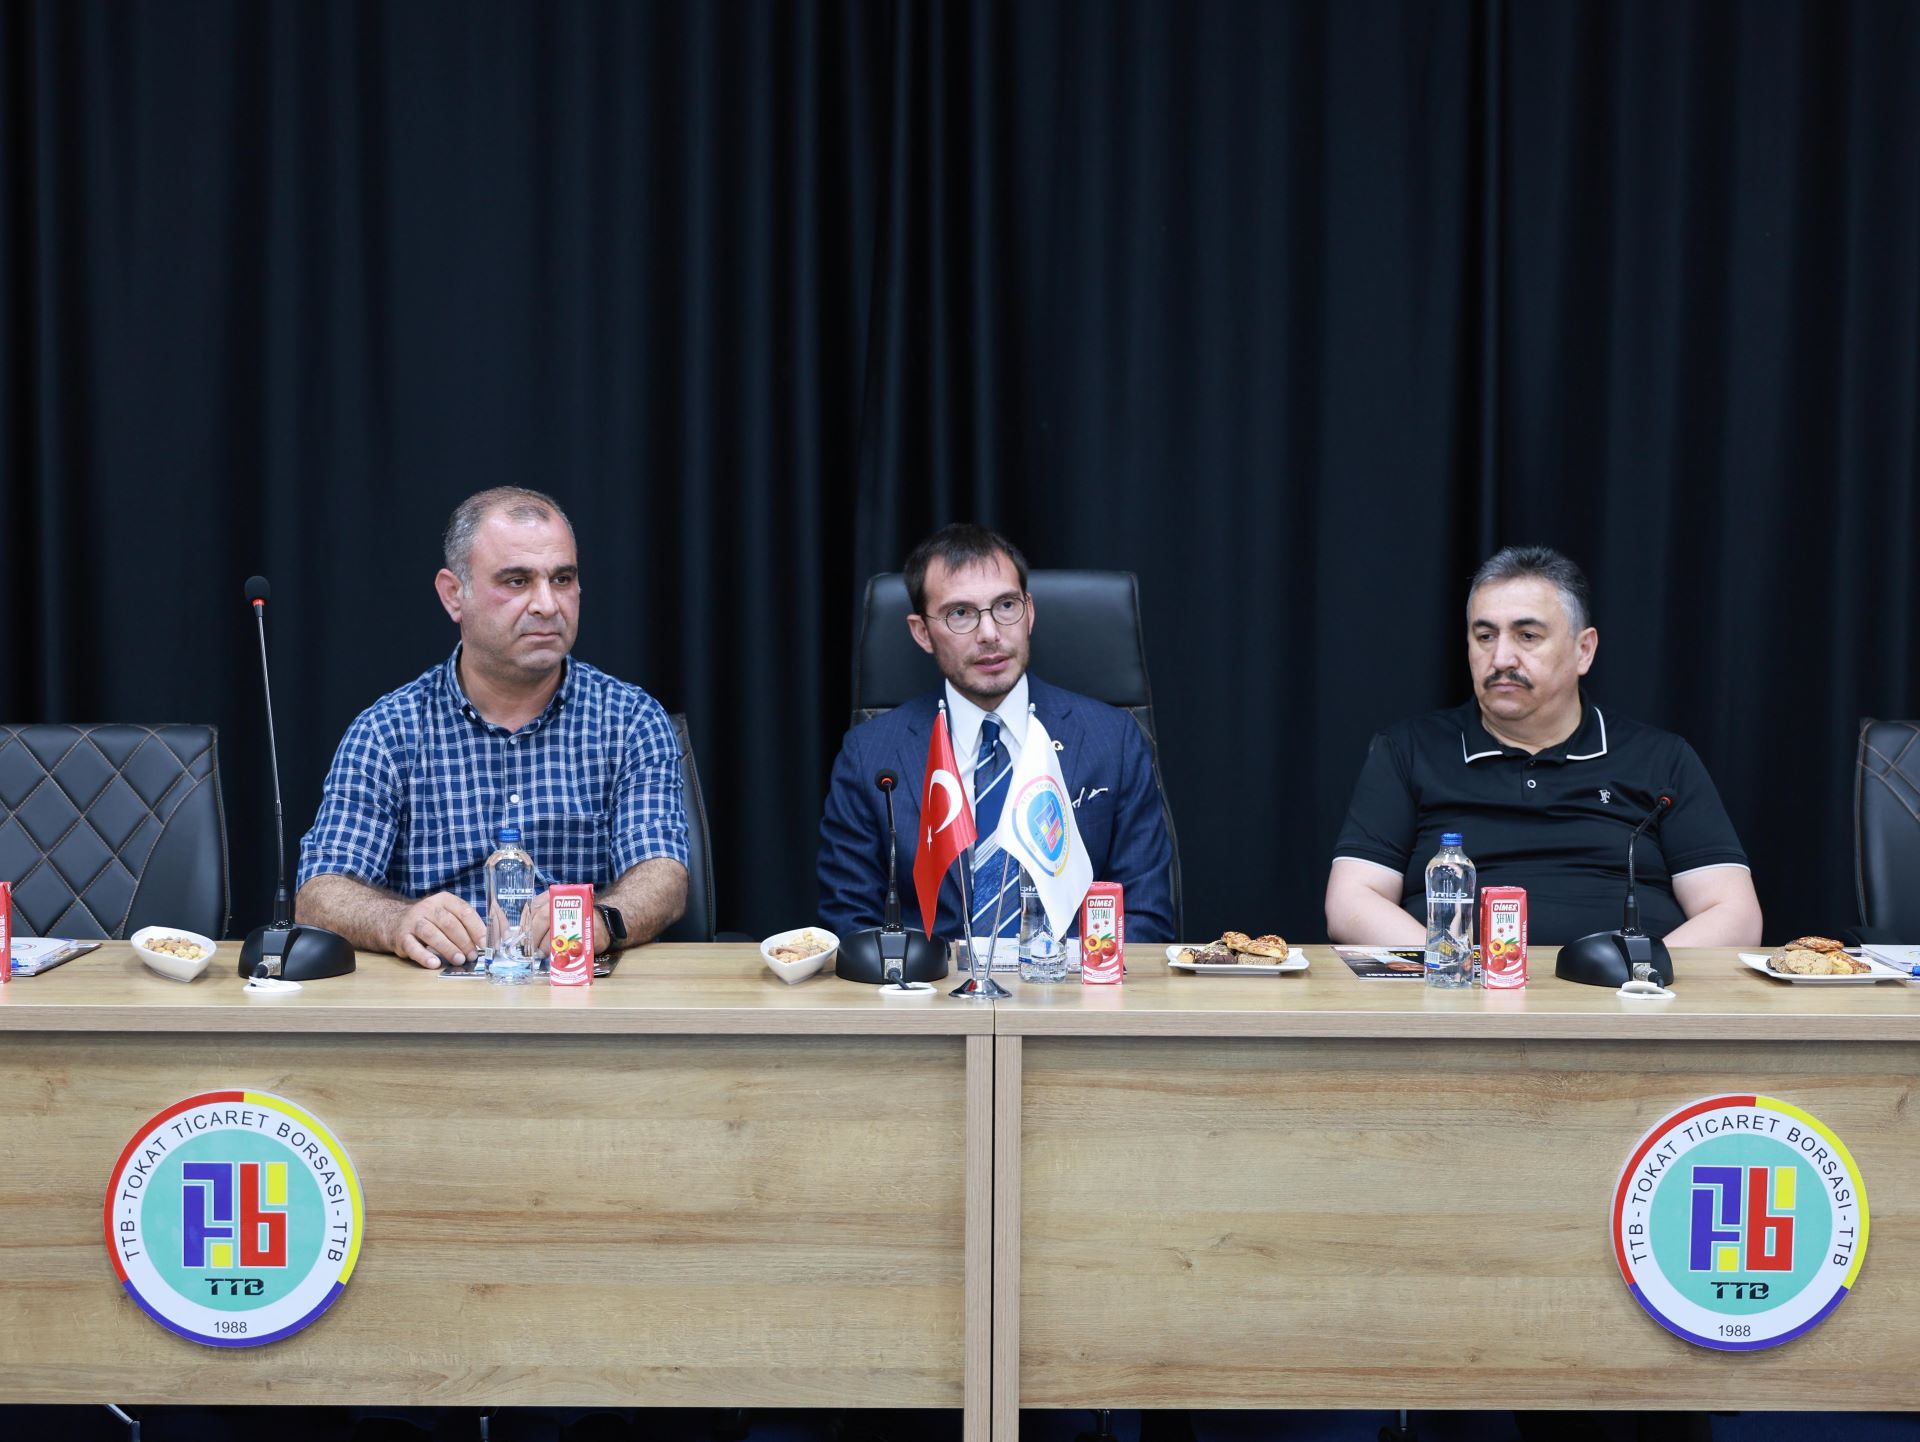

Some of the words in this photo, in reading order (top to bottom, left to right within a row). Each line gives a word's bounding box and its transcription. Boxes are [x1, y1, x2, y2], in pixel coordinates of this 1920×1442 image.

[171, 1110, 269, 1139] TİCARET
[1682, 1114, 1780, 1142] TİCARET
[204, 1278, 265, 1296] TTB
[1710, 1281, 1769, 1300] TTB
[213, 1321, 247, 1334] 1988
[1718, 1325, 1752, 1337] 1988
